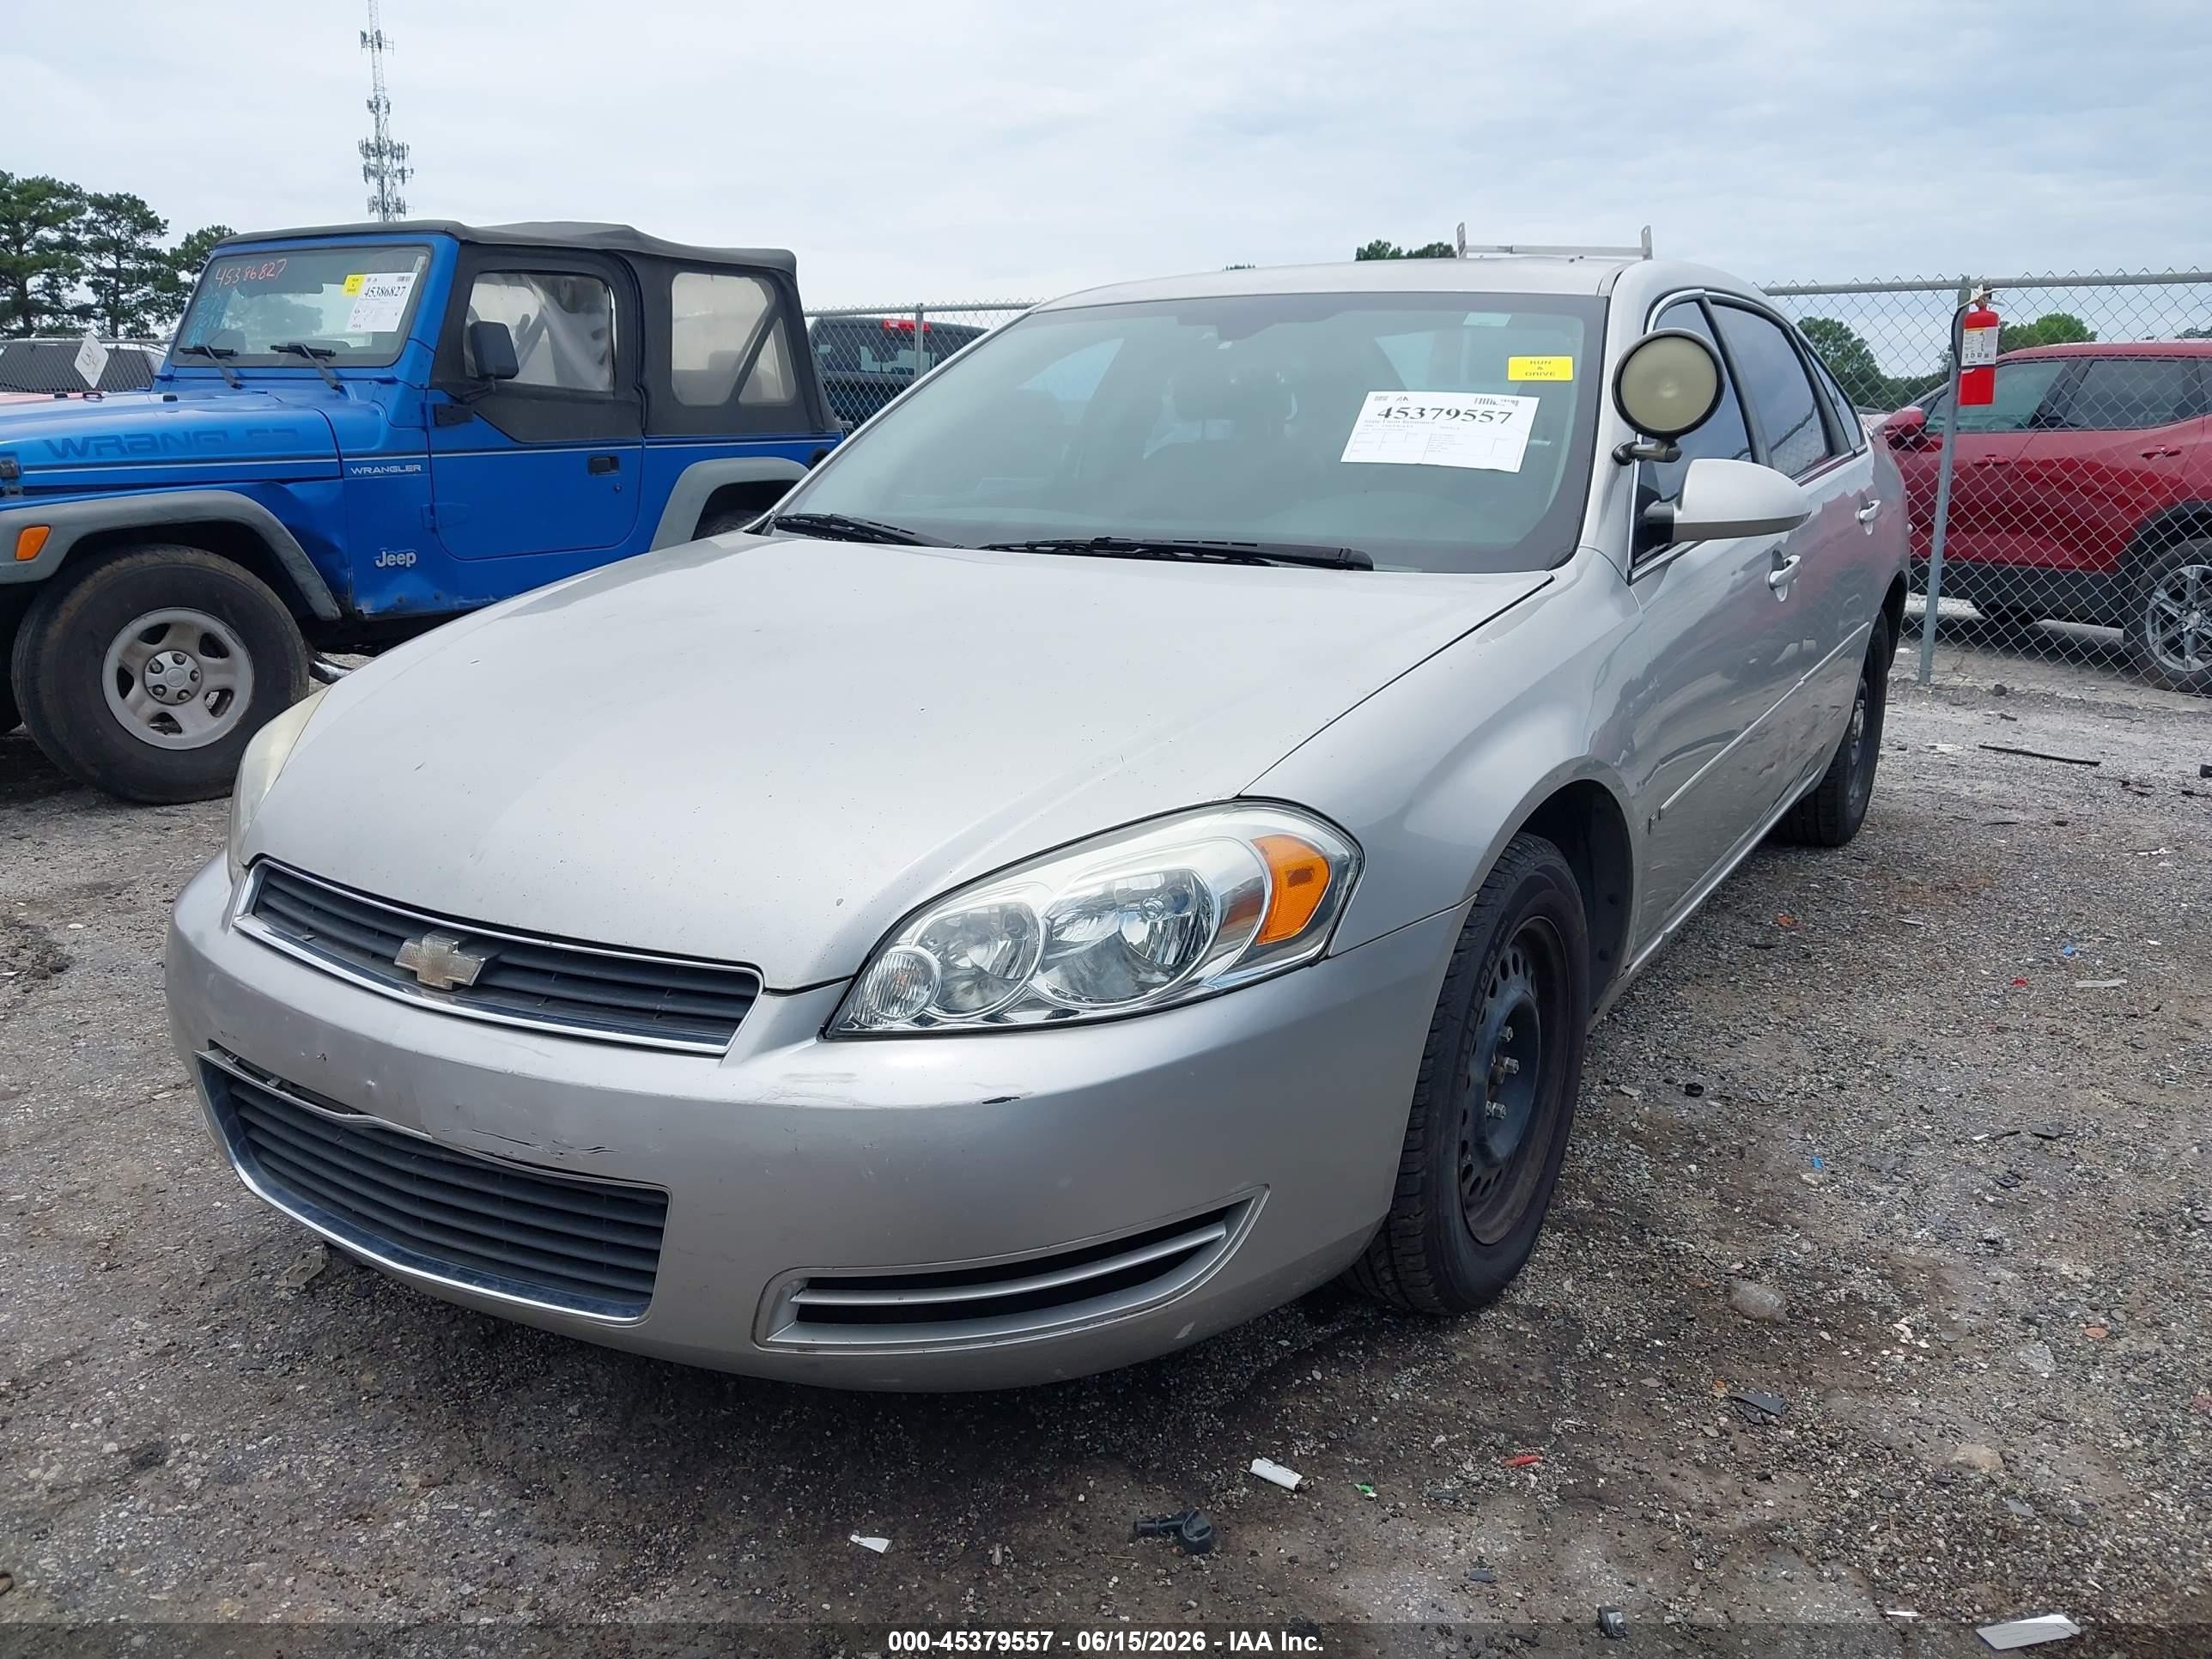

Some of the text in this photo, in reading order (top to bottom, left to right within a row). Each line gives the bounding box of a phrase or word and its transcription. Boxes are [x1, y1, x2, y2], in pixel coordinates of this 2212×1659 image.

[215, 258, 288, 288] 45386827
[364, 286, 407, 298] 45386827
[1377, 406, 1513, 424] 45379557
[349, 465, 422, 476] WRANGLER
[374, 550, 417, 568] Jeep
